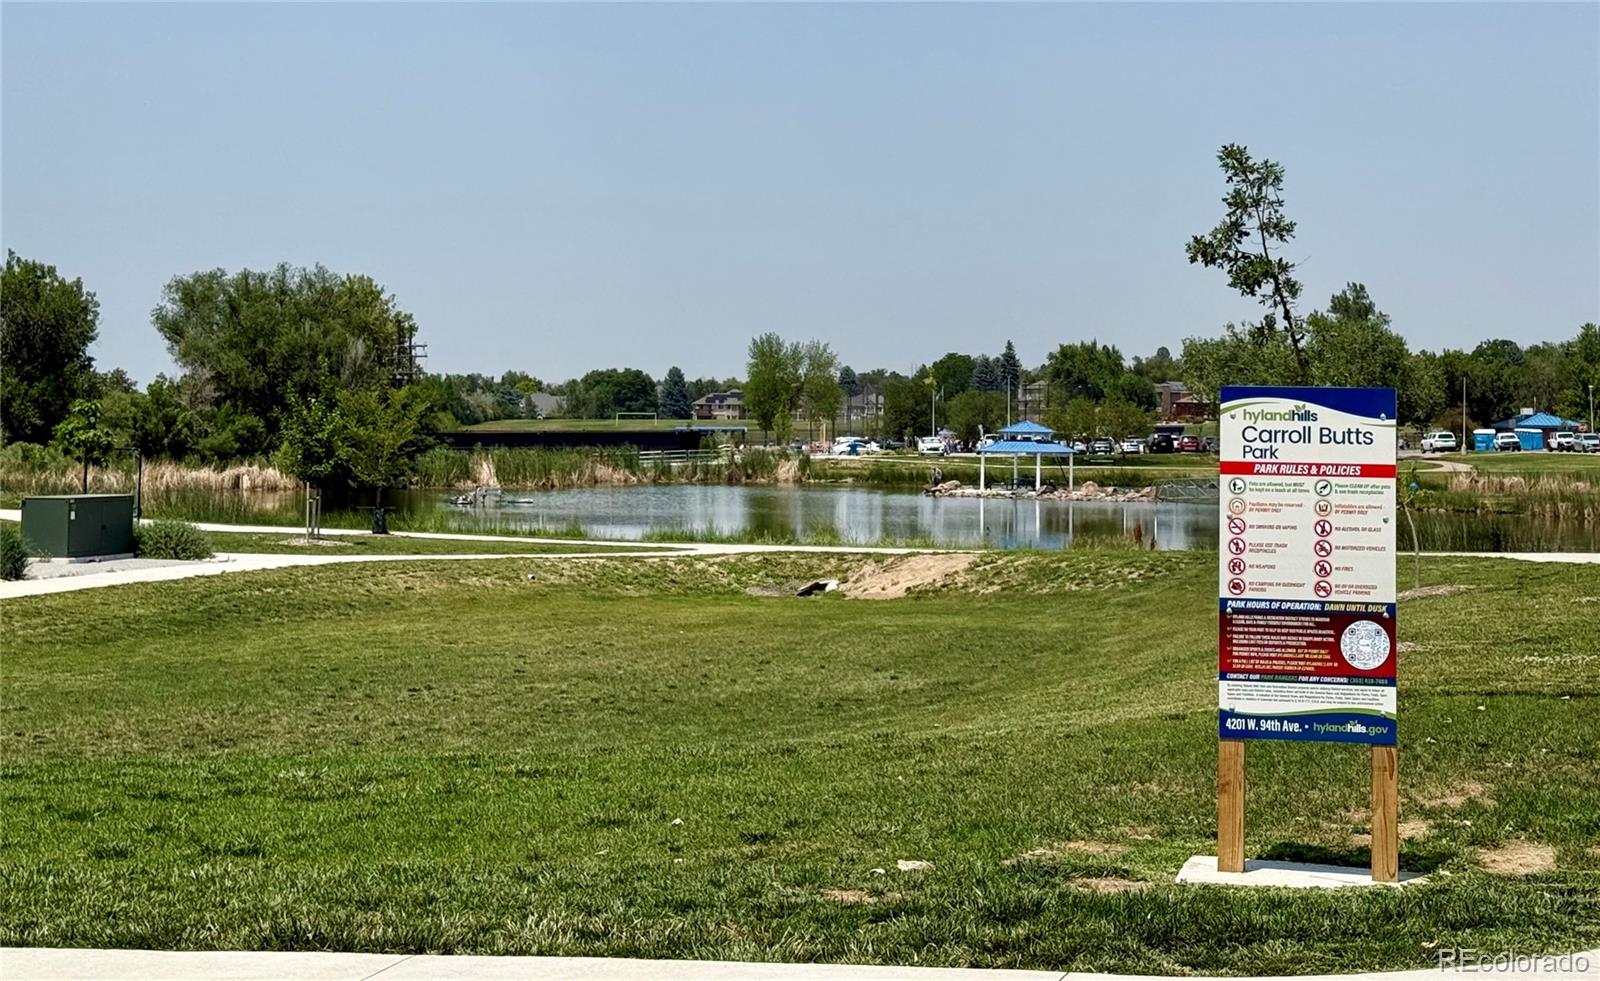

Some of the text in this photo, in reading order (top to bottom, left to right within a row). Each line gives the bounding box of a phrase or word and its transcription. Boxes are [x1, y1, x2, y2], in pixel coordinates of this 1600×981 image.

[1242, 426, 1374, 445] Carroll Butts
[1243, 445, 1278, 459] Park
[1254, 464, 1361, 476] PARK RULES & POLICIES
[1226, 718, 1388, 736] 4201 W. 94th Ave. hylandhills.gov
